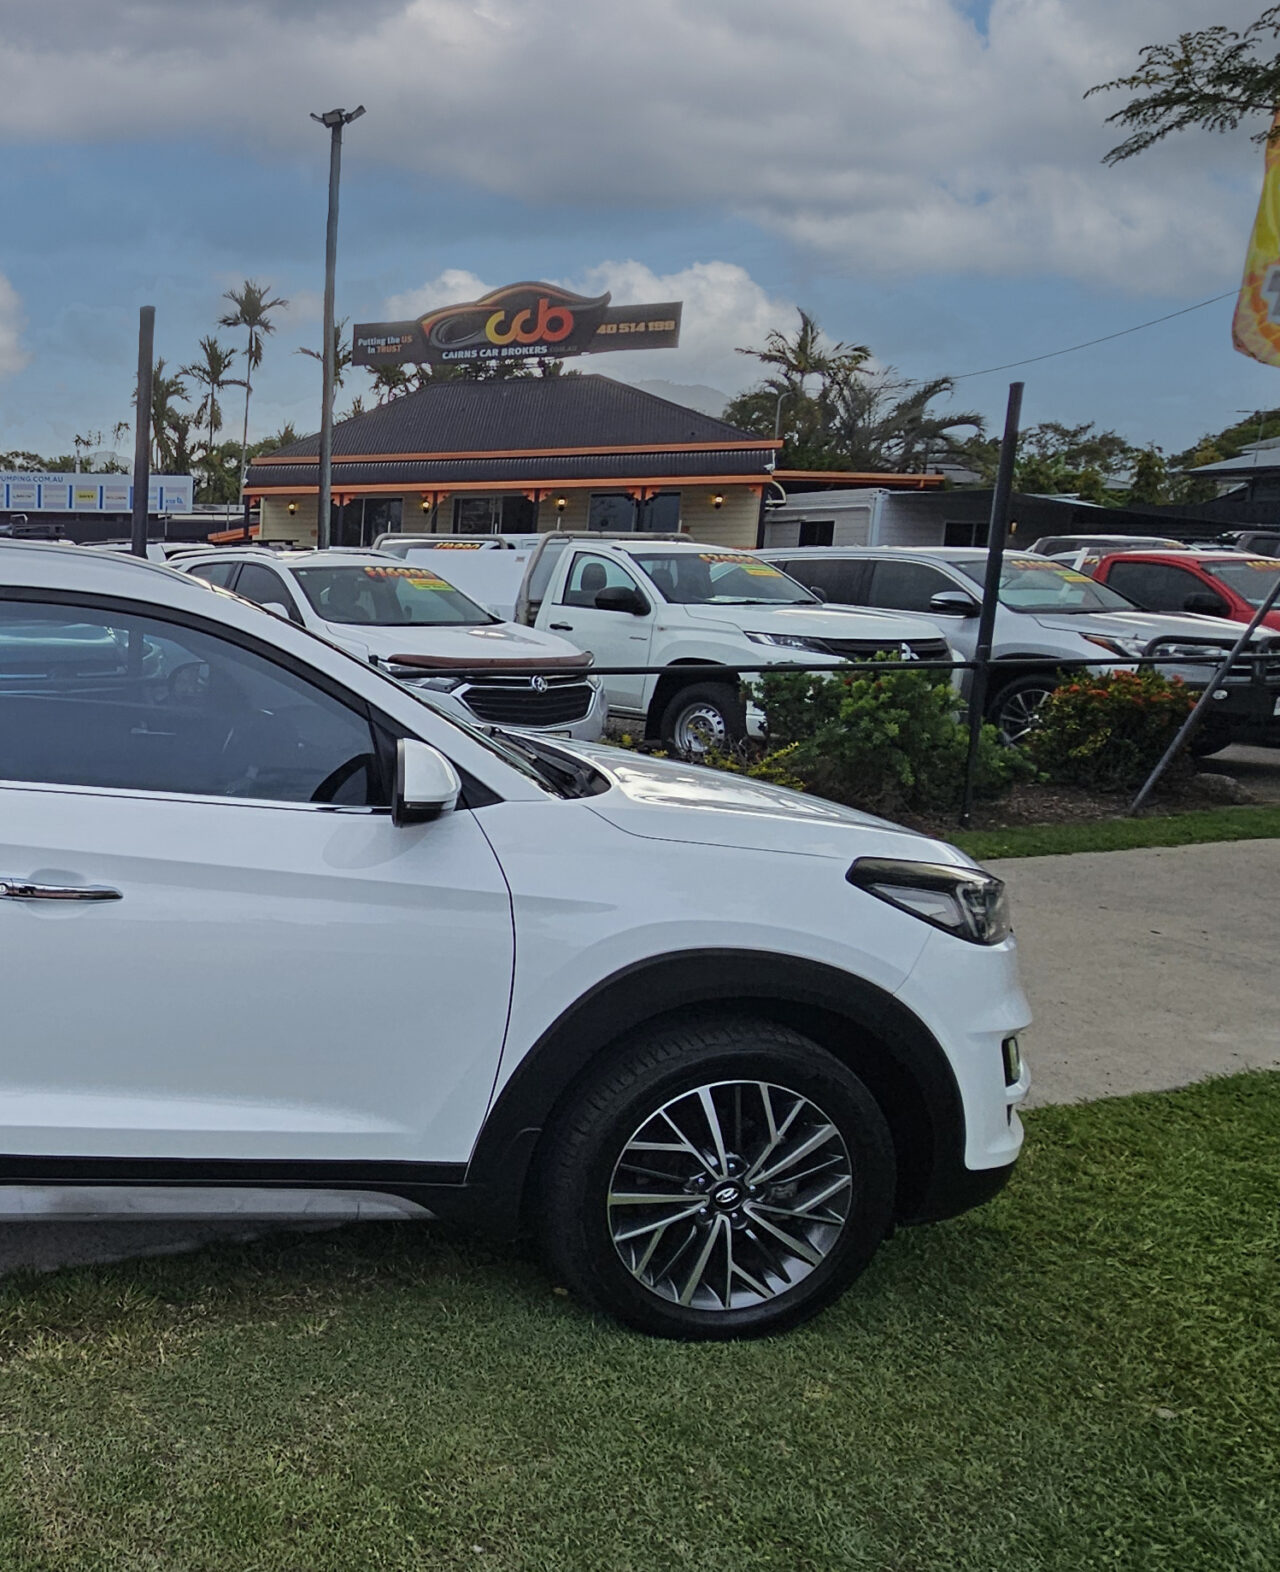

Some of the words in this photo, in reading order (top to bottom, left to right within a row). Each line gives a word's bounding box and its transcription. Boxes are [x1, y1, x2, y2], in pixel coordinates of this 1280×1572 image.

[358, 337, 386, 347] Putting
[387, 335, 400, 345] the
[401, 335, 413, 344] US
[377, 344, 401, 353] TRUST
[442, 350, 478, 360] CAIRNS
[480, 348, 499, 358] CAR
